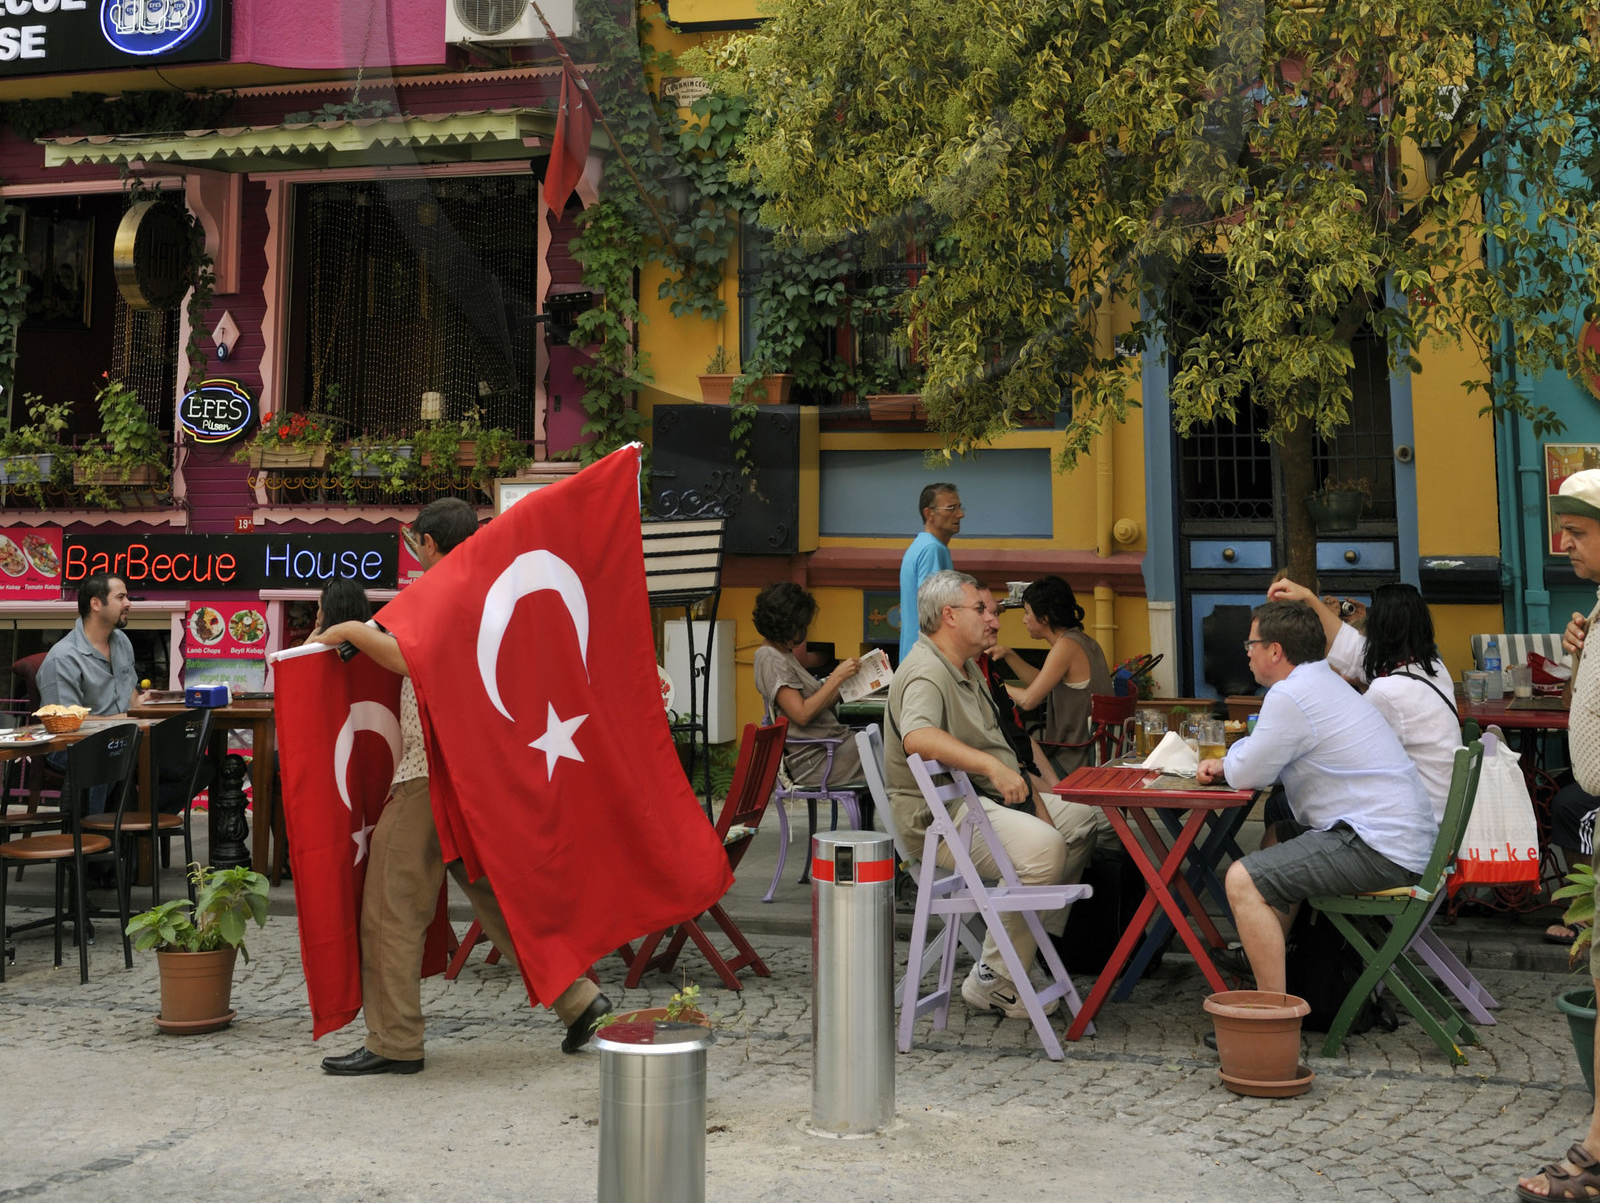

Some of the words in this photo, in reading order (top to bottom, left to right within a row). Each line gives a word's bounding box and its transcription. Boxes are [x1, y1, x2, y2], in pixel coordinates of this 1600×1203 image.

[187, 396, 242, 420] EFES
[202, 419, 231, 431] Pilsen
[65, 544, 236, 582] BarBecue
[265, 543, 383, 579] House
[230, 647, 245, 655] Beyti
